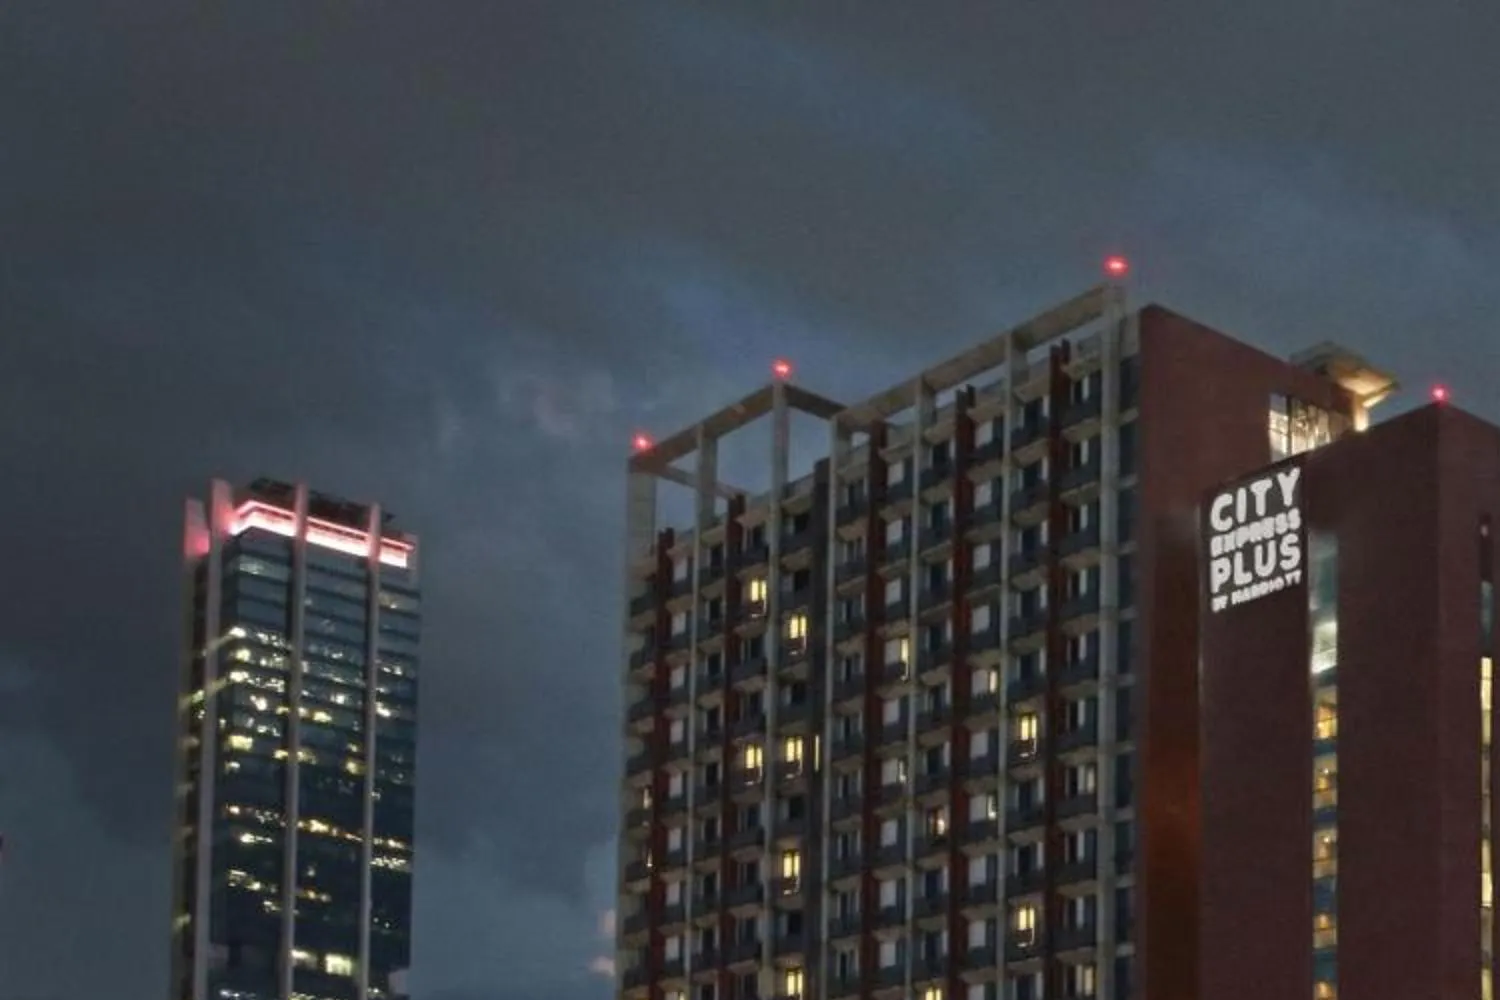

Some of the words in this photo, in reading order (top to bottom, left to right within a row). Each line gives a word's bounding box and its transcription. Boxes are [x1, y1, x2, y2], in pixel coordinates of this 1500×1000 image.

[1210, 467, 1301, 532] CITY
[1210, 507, 1301, 558] EXPRESS
[1210, 533, 1301, 594] PLUS
